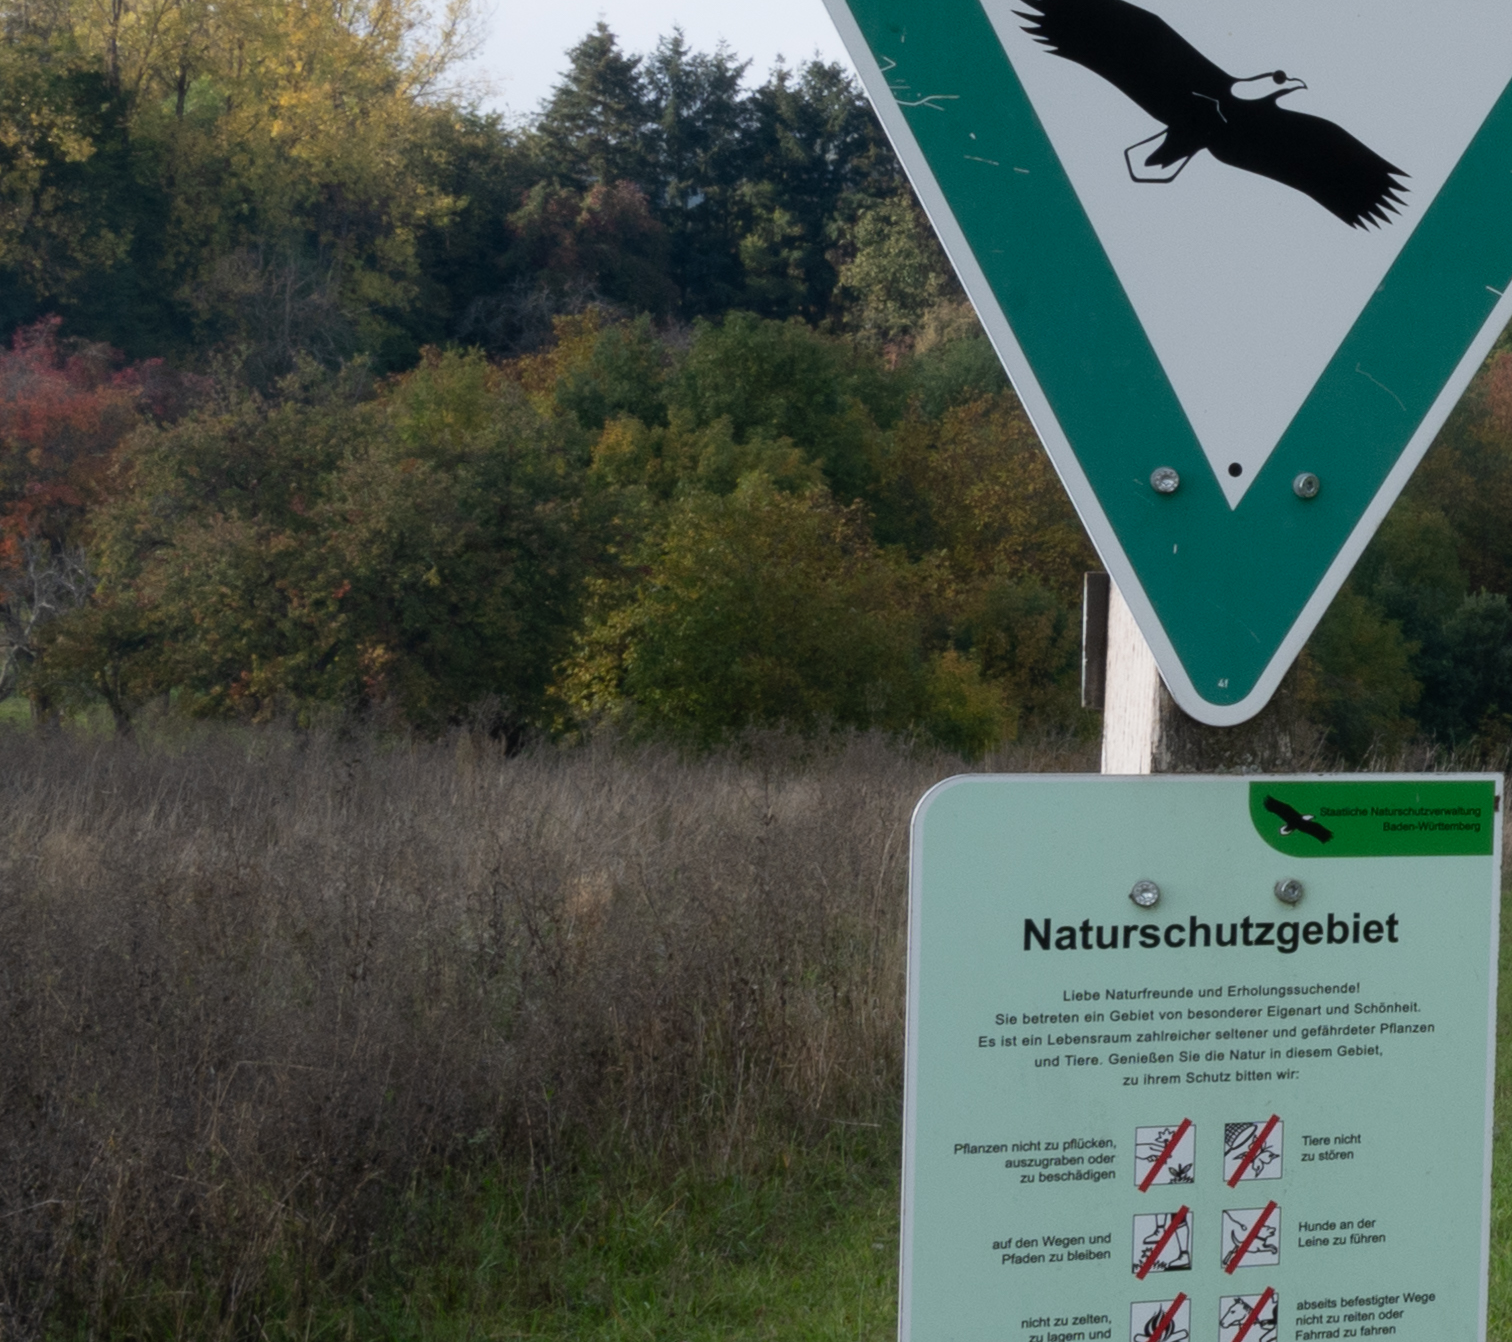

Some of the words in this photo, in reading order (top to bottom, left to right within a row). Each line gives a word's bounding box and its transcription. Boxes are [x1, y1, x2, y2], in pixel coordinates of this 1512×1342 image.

[1320, 807, 1368, 817] Staatliche
[1370, 806, 1482, 818] Naturschutzverwaltung
[1382, 821, 1481, 833] Baden-Württemberg
[1022, 911, 1400, 955] Naturschutzgebiet
[1062, 989, 1101, 1002] Liebe
[1104, 986, 1194, 1001] Naturfreunde
[1197, 985, 1224, 999] und
[1227, 981, 1361, 999] Erholungssuchende!
[994, 1012, 1018, 1026] Sie
[1022, 1012, 1080, 1025] betreten
[1083, 1010, 1105, 1023] ein
[1109, 1009, 1155, 1023] Gebiet
[1158, 1010, 1183, 1021] von
[1186, 1006, 1264, 1020] besonderer
[1266, 1004, 1322, 1020] Eigenart
[1325, 1003, 1350, 1016] und
[1353, 1001, 1422, 1015] Schönheit.
[977, 1035, 997, 1049] Es
[1000, 1035, 1018, 1048] ist
[1021, 1033, 1043, 1047] ein
[1047, 1032, 1132, 1046] Lebensraum
[1135, 1029, 1212, 1043] zahlreicher
[1214, 1027, 1269, 1041] seltener
[1272, 1025, 1298, 1039] und
[1300, 1024, 1377, 1040] gefährdeter
[1379, 1021, 1436, 1035] Pflanzen
[1034, 1055, 1061, 1068] und
[1063, 1054, 1104, 1067] Tiere.
[1107, 1051, 1175, 1066] Genießen
[1178, 1050, 1201, 1063] Sie
[1204, 1049, 1226, 1062] die
[1229, 1049, 1267, 1061] Natur
[1269, 1047, 1282, 1060] in
[1285, 1046, 1333, 1059] diesem
[1336, 1044, 1384, 1057] Gebiet,
[1122, 1076, 1139, 1087] zu
[1143, 1073, 1182, 1086] ihrem
[1185, 1071, 1232, 1084] Schutz
[1235, 1069, 1273, 1083] bitten
[1275, 1067, 1300, 1081] wir:
[953, 1142, 1009, 1156] Pflanzen
[1011, 1140, 1042, 1153] nicht
[1043, 1141, 1060, 1152] zu
[1062, 1137, 1117, 1152] pflücken,
[1301, 1134, 1332, 1147] Tiere
[1333, 1133, 1362, 1145] nicht
[1004, 1154, 1085, 1170] auszugraben
[1087, 1152, 1117, 1165] oder
[1300, 1152, 1316, 1163] zu
[1317, 1149, 1355, 1162] stören
[1019, 1174, 1036, 1184] zu
[1038, 1168, 1117, 1183] beschädigen
[1298, 1219, 1337, 1233] Hunde
[1338, 1220, 1355, 1231] an
[1356, 1217, 1377, 1230] der
[992, 1237, 1013, 1250] auf
[1014, 1237, 1039, 1249] den
[1041, 1235, 1086, 1249] Wegen
[1088, 1232, 1112, 1245] und
[1297, 1235, 1330, 1248] Leine
[1332, 1236, 1347, 1246] zu
[1349, 1232, 1387, 1245] führen
[1001, 1253, 1046, 1265] Pfaden
[1048, 1251, 1065, 1263] zu
[1066, 1249, 1111, 1262] bleiben
[1295, 1297, 1338, 1311] abseits
[1339, 1295, 1401, 1310] befestigter
[1402, 1291, 1437, 1305] Wege
[1020, 1316, 1051, 1330] nicht
[1052, 1316, 1069, 1328] zu
[1071, 1313, 1112, 1326] zelten,
[1295, 1313, 1324, 1327] nicht
[1325, 1314, 1341, 1325] zu
[1342, 1311, 1376, 1323] reiten
[1377, 1308, 1405, 1320] oder
[1088, 1327, 1112, 1340] und
[1294, 1327, 1341, 1342] Fahrrad
[1342, 1328, 1358, 1339] zu
[1359, 1324, 1397, 1337] fahren
